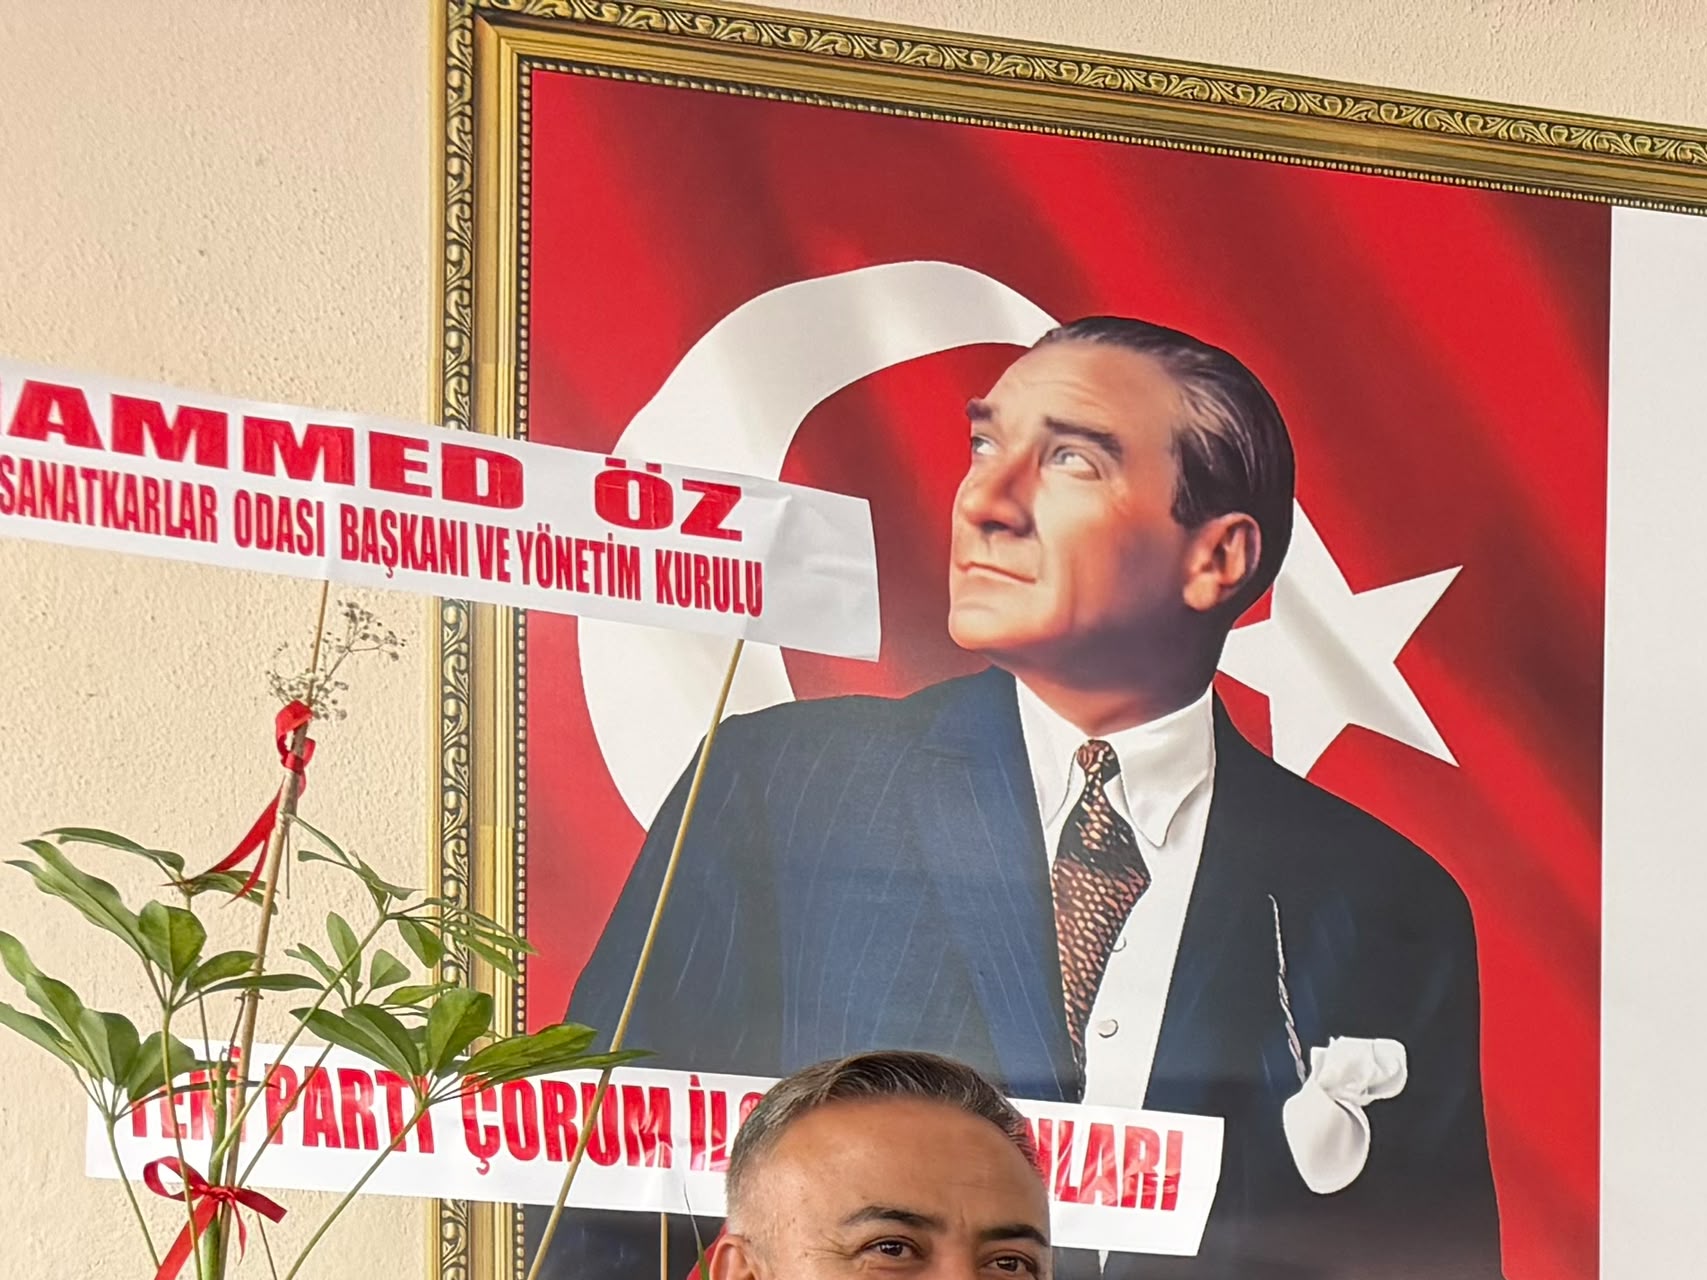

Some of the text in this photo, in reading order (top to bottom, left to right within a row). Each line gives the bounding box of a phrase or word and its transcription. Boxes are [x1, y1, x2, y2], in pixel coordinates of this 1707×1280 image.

[0, 379, 743, 542] AMMED ÖZ
[0, 456, 764, 617] SANATKARLAR ODASI BAŞKANI VE YÖNETİM KURULU
[460, 1073, 673, 1175] ÇORUM
